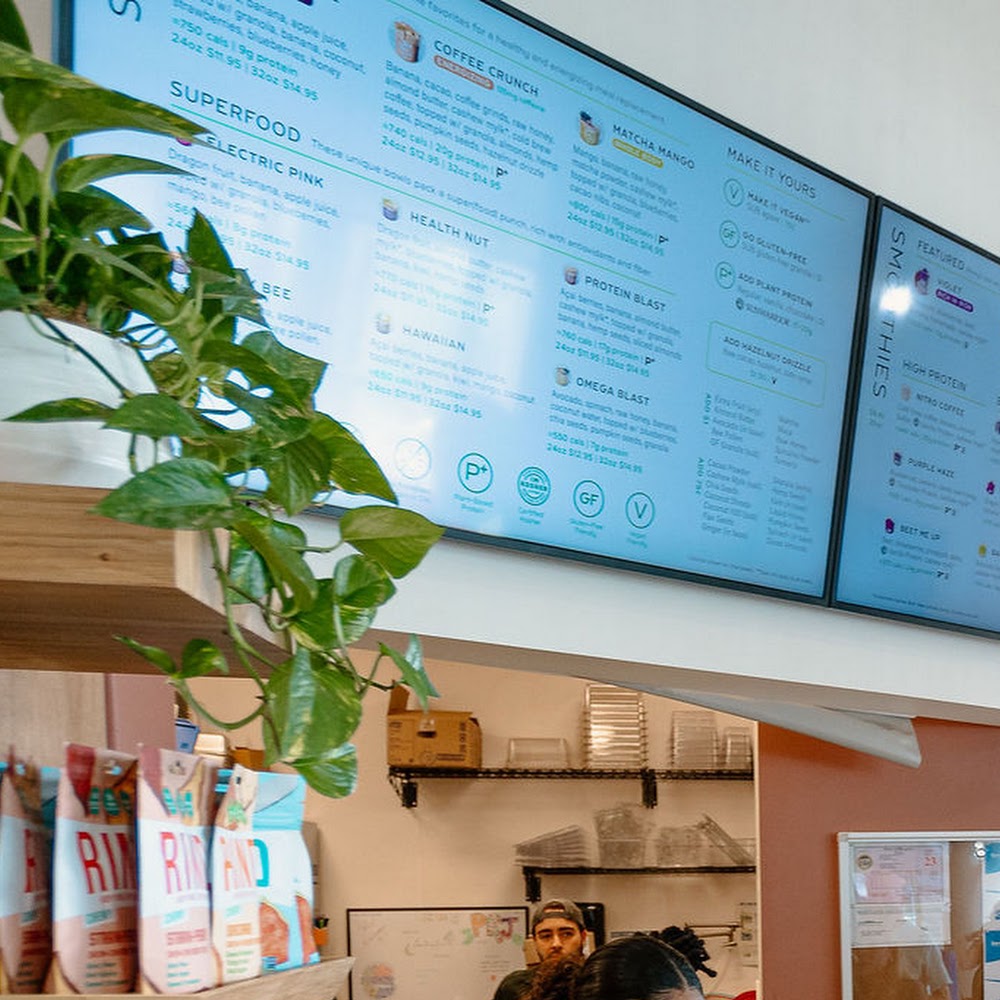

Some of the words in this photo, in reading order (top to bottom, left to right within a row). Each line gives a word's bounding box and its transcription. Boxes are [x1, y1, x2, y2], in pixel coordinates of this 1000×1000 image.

[434, 38, 484, 73] COFFEE
[487, 63, 539, 98] CRUNCH
[169, 79, 301, 144] SUPERFOOD
[612, 122, 655, 152] MATCHA
[657, 143, 695, 171] MANGO
[288, 164, 323, 189] PINK
[726, 145, 762, 174] MAKE
[763, 163, 775, 180] IT
[777, 170, 817, 200] YOURS
[409, 209, 461, 239] HEALTH
[463, 229, 490, 249] NUT
[916, 239, 965, 272] FEATURED
[262, 281, 292, 302] BEE
[584, 274, 631, 301] PROTEIN
[633, 292, 666, 313] BLAST
[872, 227, 906, 398] SMTHIES
[401, 323, 466, 353] HAWAIIAN
[575, 376, 615, 397] OMEGA
[616, 388, 650, 407] BLAST
[902, 358, 926, 378] HIGH
[928, 368, 967, 393] PROTEIN
[578, 490, 599, 507] GF
[632, 500, 648, 520] V
